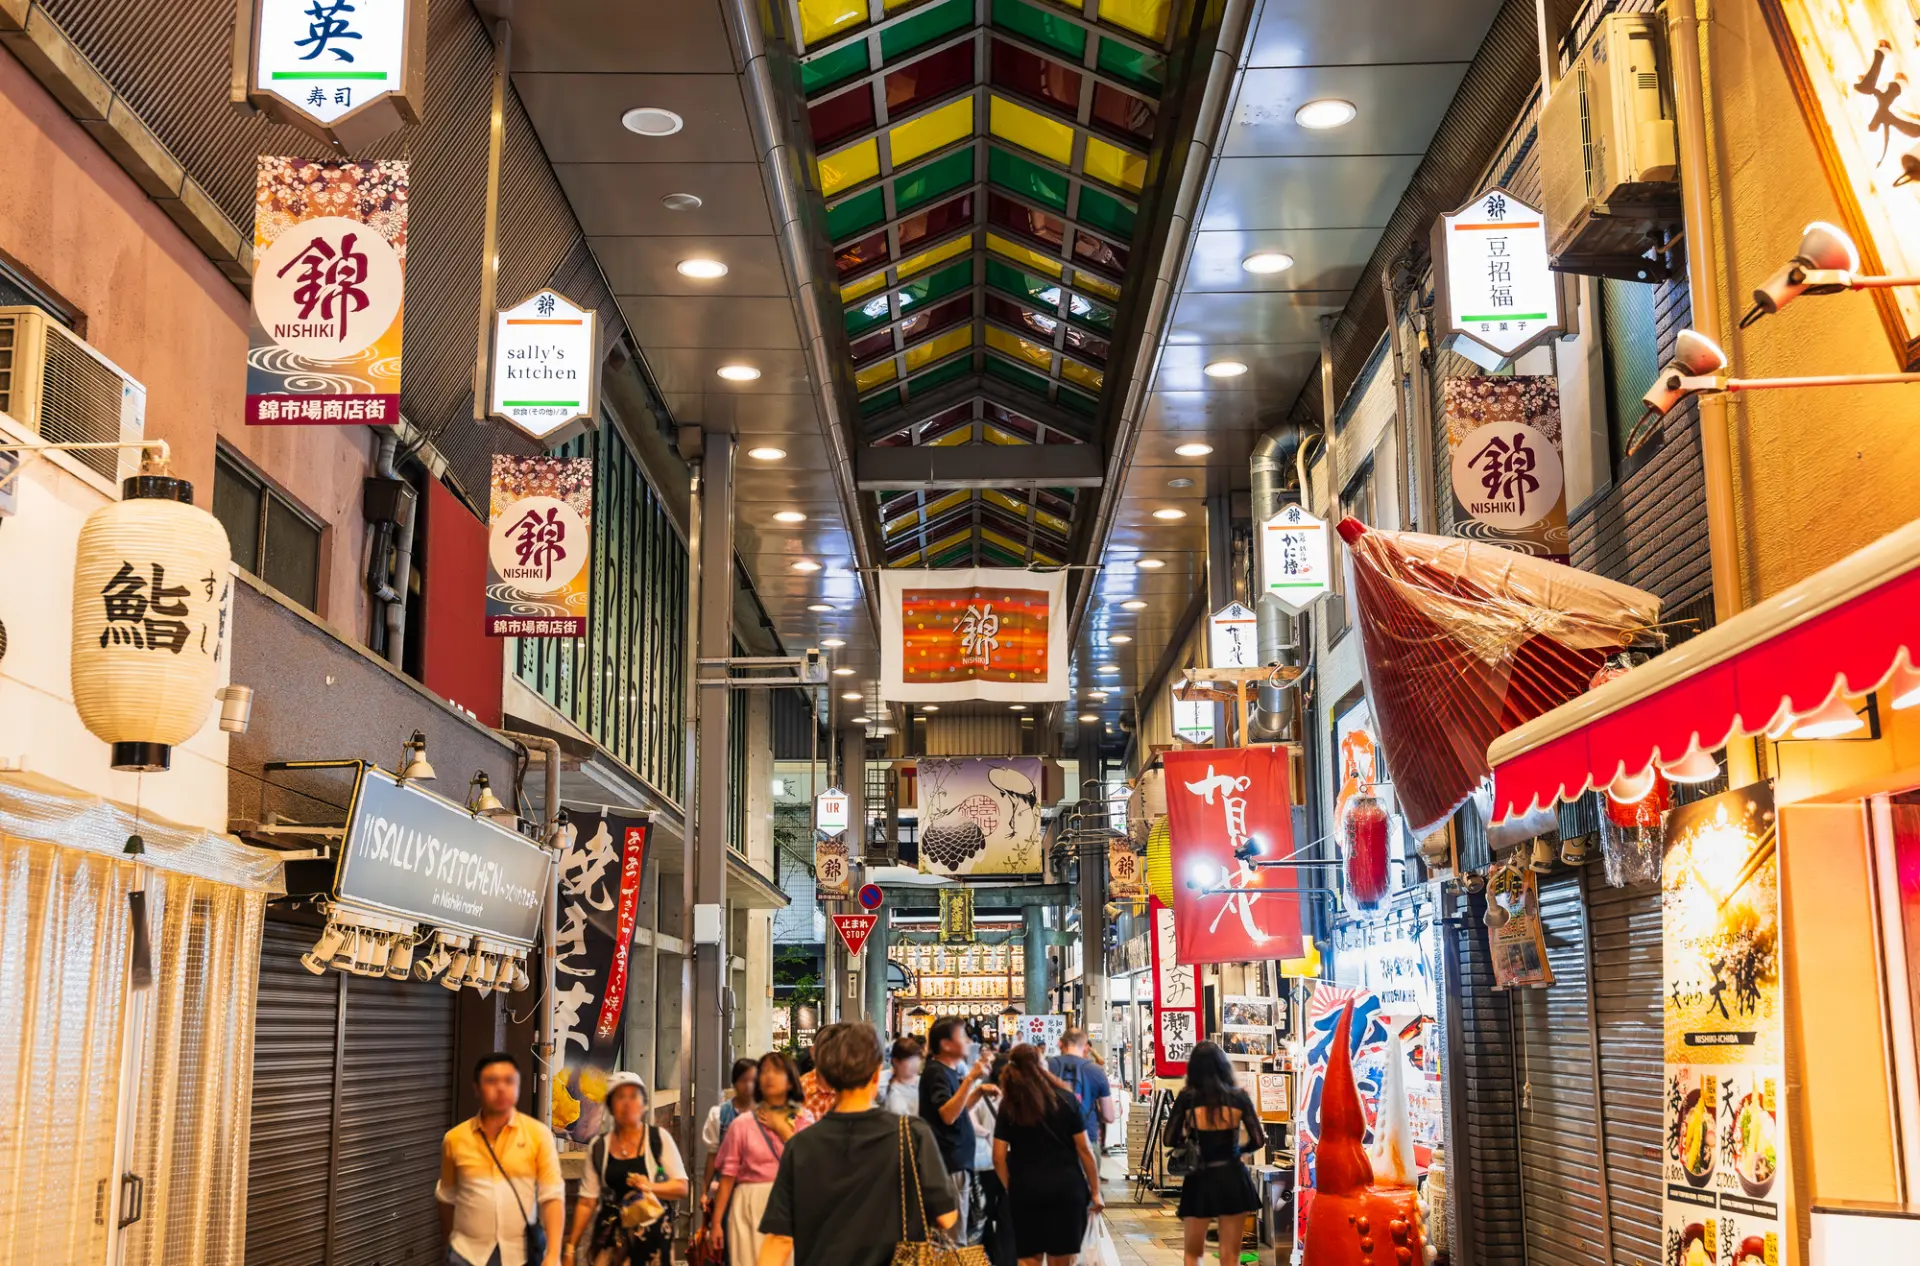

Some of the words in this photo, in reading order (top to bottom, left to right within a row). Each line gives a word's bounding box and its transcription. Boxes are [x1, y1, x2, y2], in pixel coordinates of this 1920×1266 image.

[294, 0, 362, 63] 英
[306, 87, 352, 108] 寿司
[1483, 195, 1506, 220] 錦
[1486, 236, 1513, 307] 豆招福
[277, 233, 370, 342] 錦
[534, 294, 555, 317] 錦
[274, 324, 334, 338] NISHIKI
[1481, 322, 1527, 332] 豆菓子
[507, 345, 565, 363] sally's
[507, 365, 577, 380] kitchen
[258, 399, 386, 420] 錦市場商店街
[1467, 433, 1540, 516] 錦
[1471, 502, 1516, 514] NISHIKI
[504, 507, 566, 582] 錦
[503, 568, 543, 579] NISHIKI
[100, 560, 190, 654] 鮨
[200, 569, 217, 655] すし
[493, 620, 578, 634] 錦市場商店街
[952, 603, 999, 666] 錦
[962, 656, 986, 665] NISHIKI
[826, 802, 840, 813] UR
[371, 816, 440, 876] SALLY'S
[821, 858, 842, 882] 錦
[1114, 855, 1135, 881] 錦
[432, 889, 439, 905] in
[841, 919, 869, 929] 止まれ
[846, 930, 866, 939] STOP
[1163, 1012, 1190, 1031] 漬物
[1695, 1033, 1739, 1043] NISHIKI-ICHIBA
